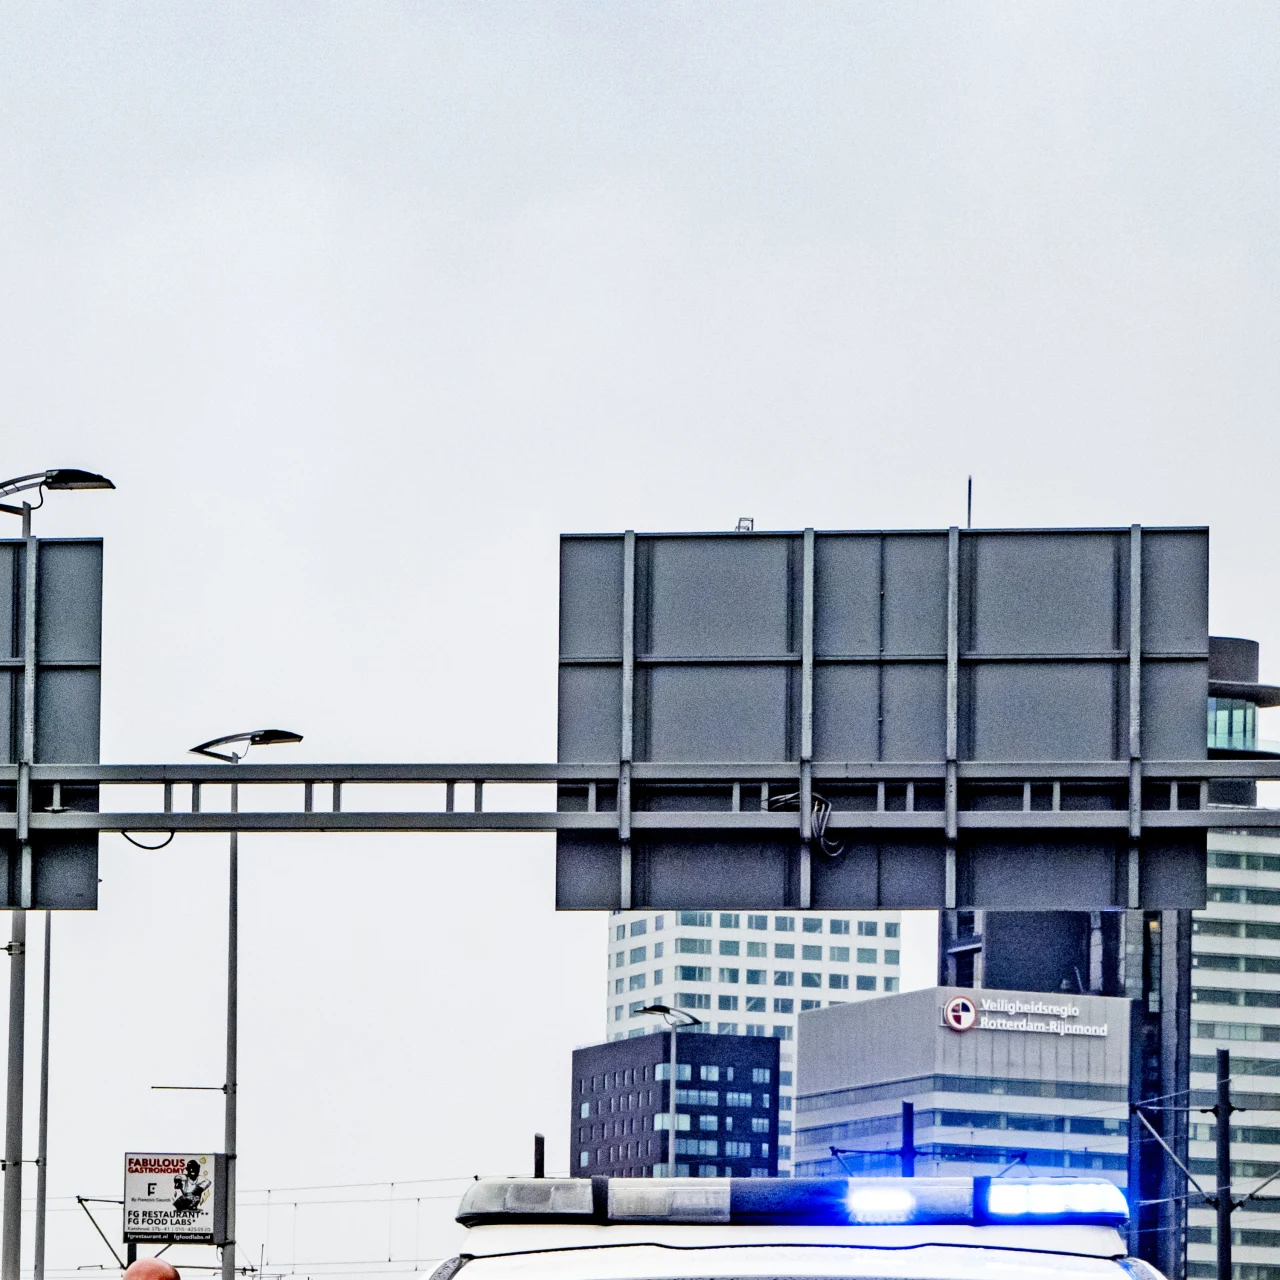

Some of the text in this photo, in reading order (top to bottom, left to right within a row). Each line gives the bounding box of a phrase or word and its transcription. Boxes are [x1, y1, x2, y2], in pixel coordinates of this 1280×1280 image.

[981, 998, 1080, 1018] Veiligheidsregio
[980, 1017, 1108, 1036] Rotterdam-Rijnmond
[127, 1158, 186, 1168] FABULOUS
[127, 1210, 140, 1218] FG
[127, 1218, 140, 1226] FG
[141, 1218, 168, 1226] FOOD
